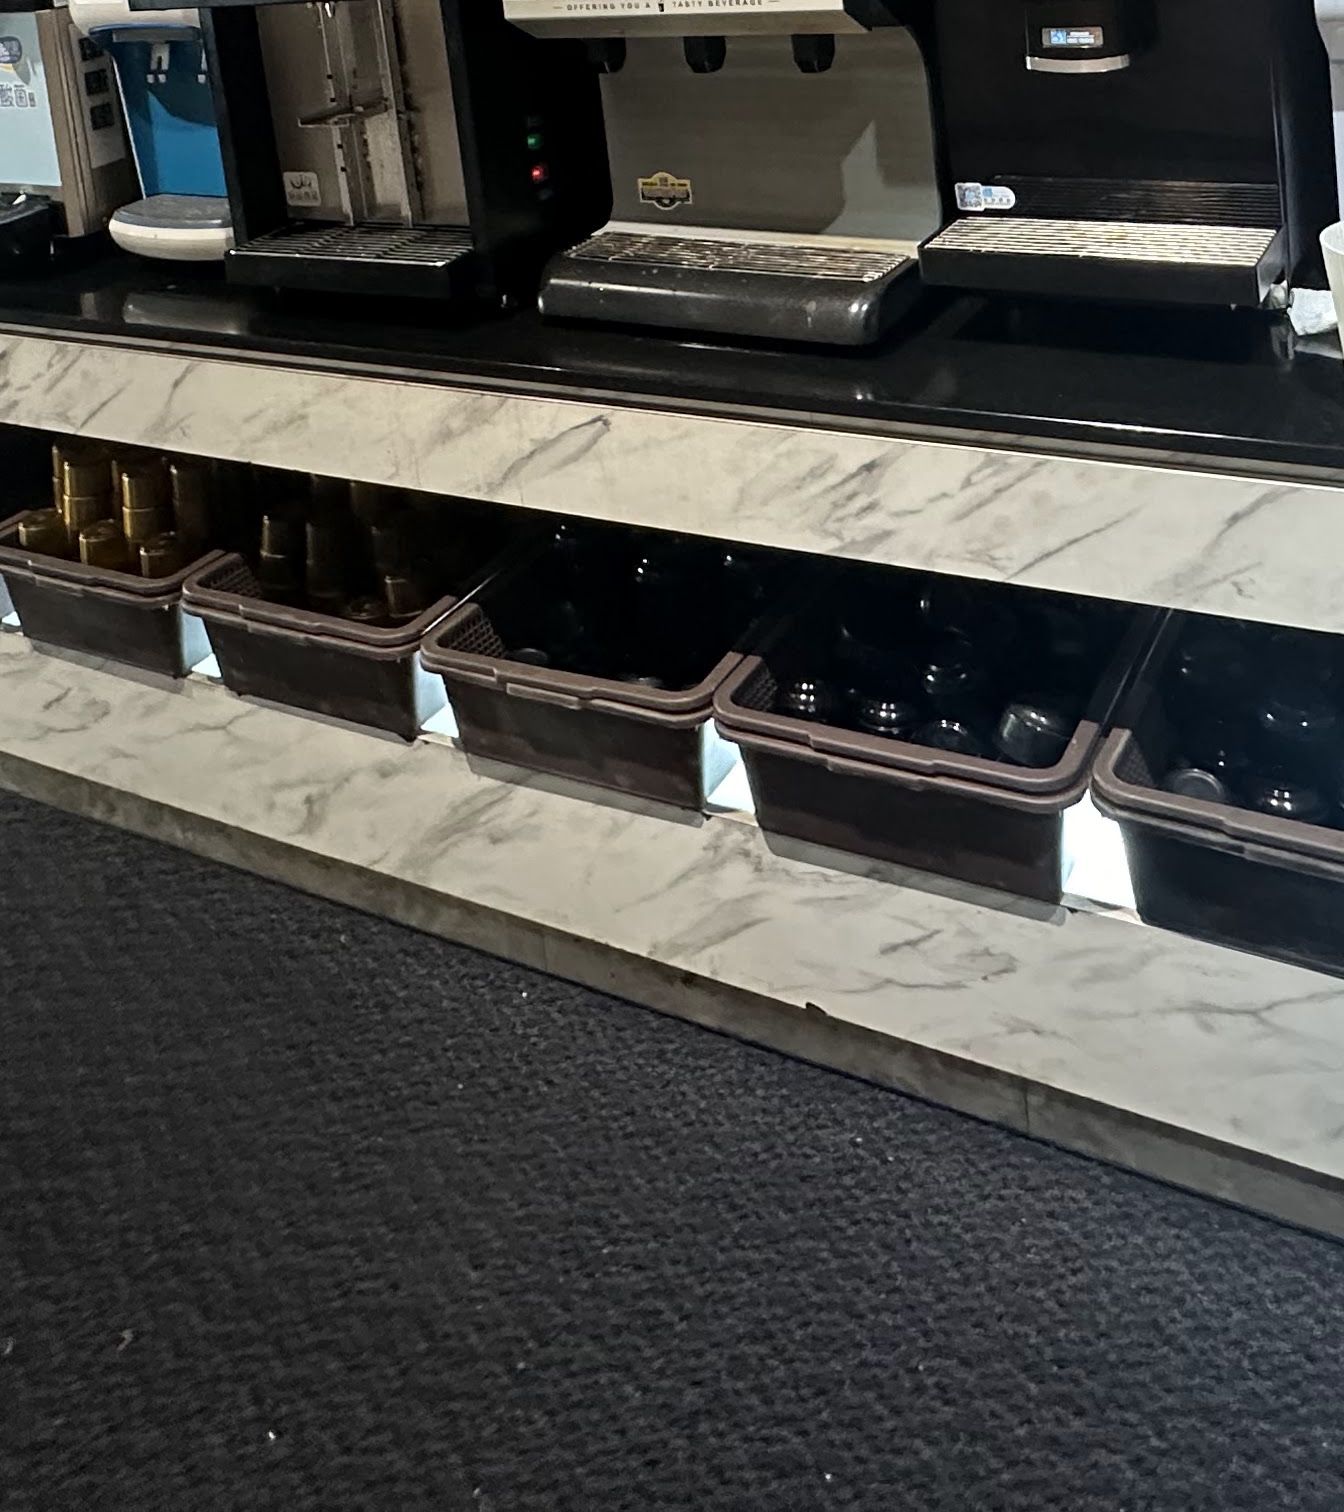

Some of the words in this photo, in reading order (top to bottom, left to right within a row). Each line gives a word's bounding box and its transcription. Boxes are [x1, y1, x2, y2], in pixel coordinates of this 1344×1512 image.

[567, 2, 616, 11] OFFERING
[620, 1, 640, 10] YOU
[672, 0, 703, 8] TASTY
